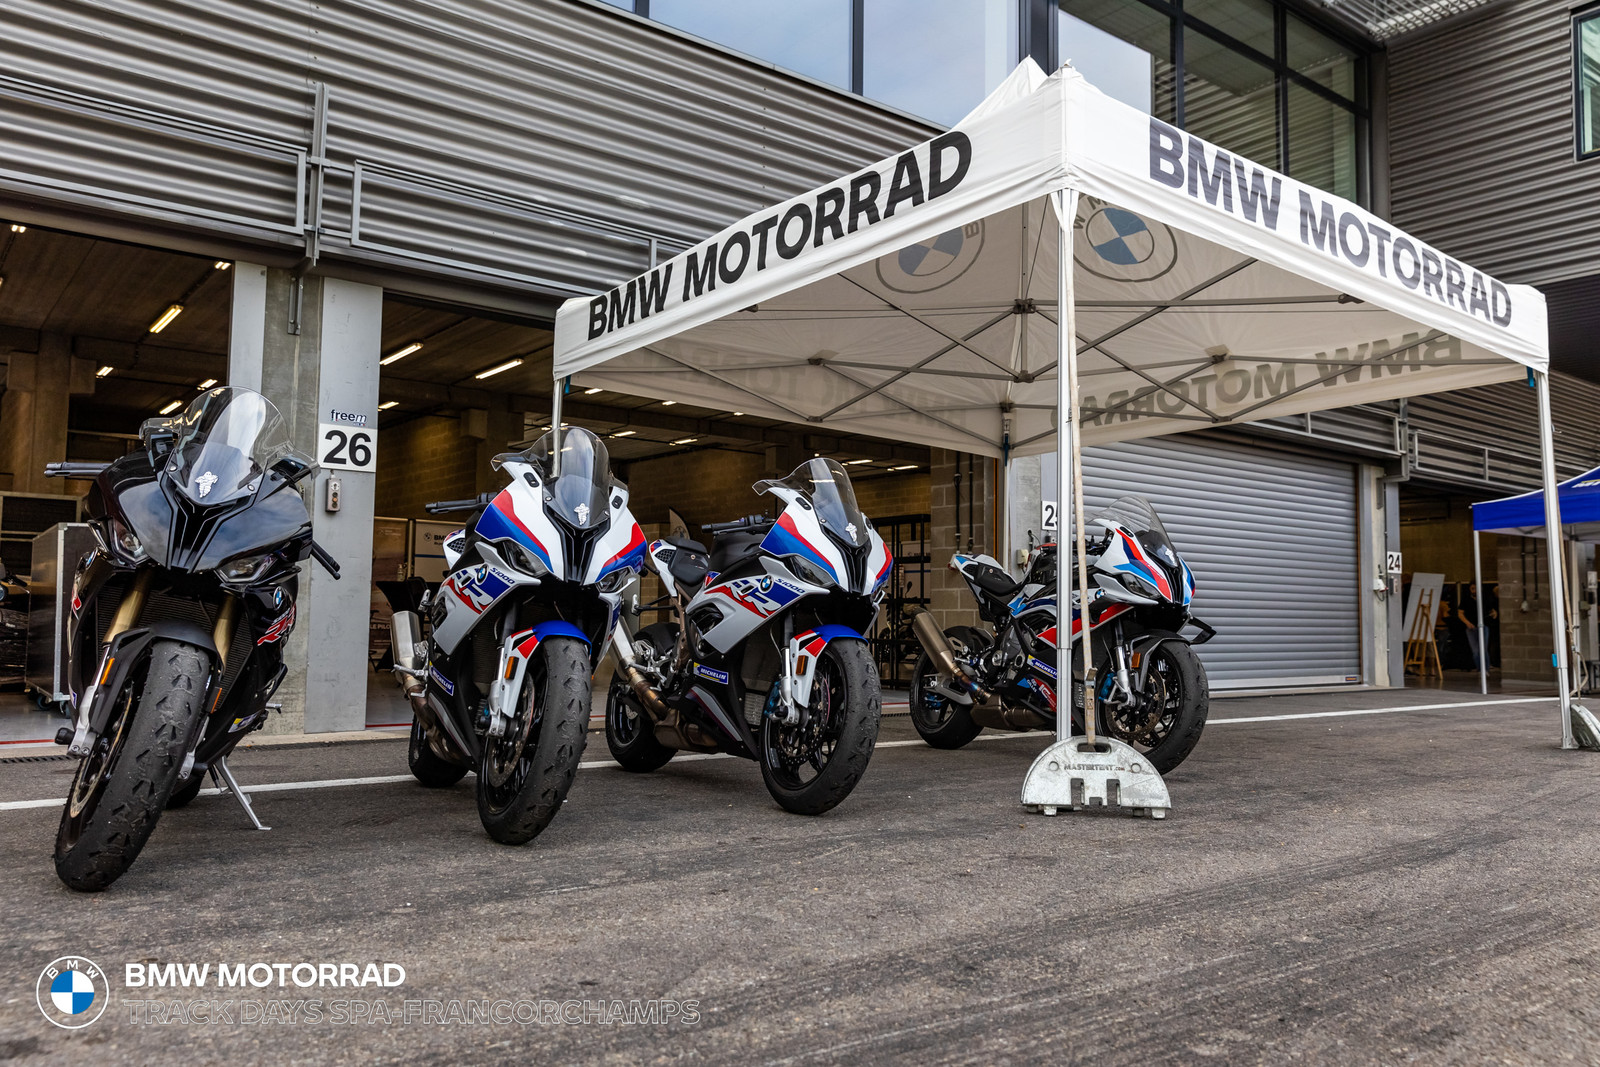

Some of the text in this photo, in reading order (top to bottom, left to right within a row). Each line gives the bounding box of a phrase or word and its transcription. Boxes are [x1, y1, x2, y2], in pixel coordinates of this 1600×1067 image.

[1150, 116, 1512, 328] BMW MOTORRAD
[588, 131, 972, 340] BMW MOTORRAD
[331, 409, 367, 422] freem
[323, 430, 371, 467] 26
[1045, 505, 1057, 527] 2
[1388, 554, 1401, 571] 24
[700, 668, 727, 680] MICHELIN
